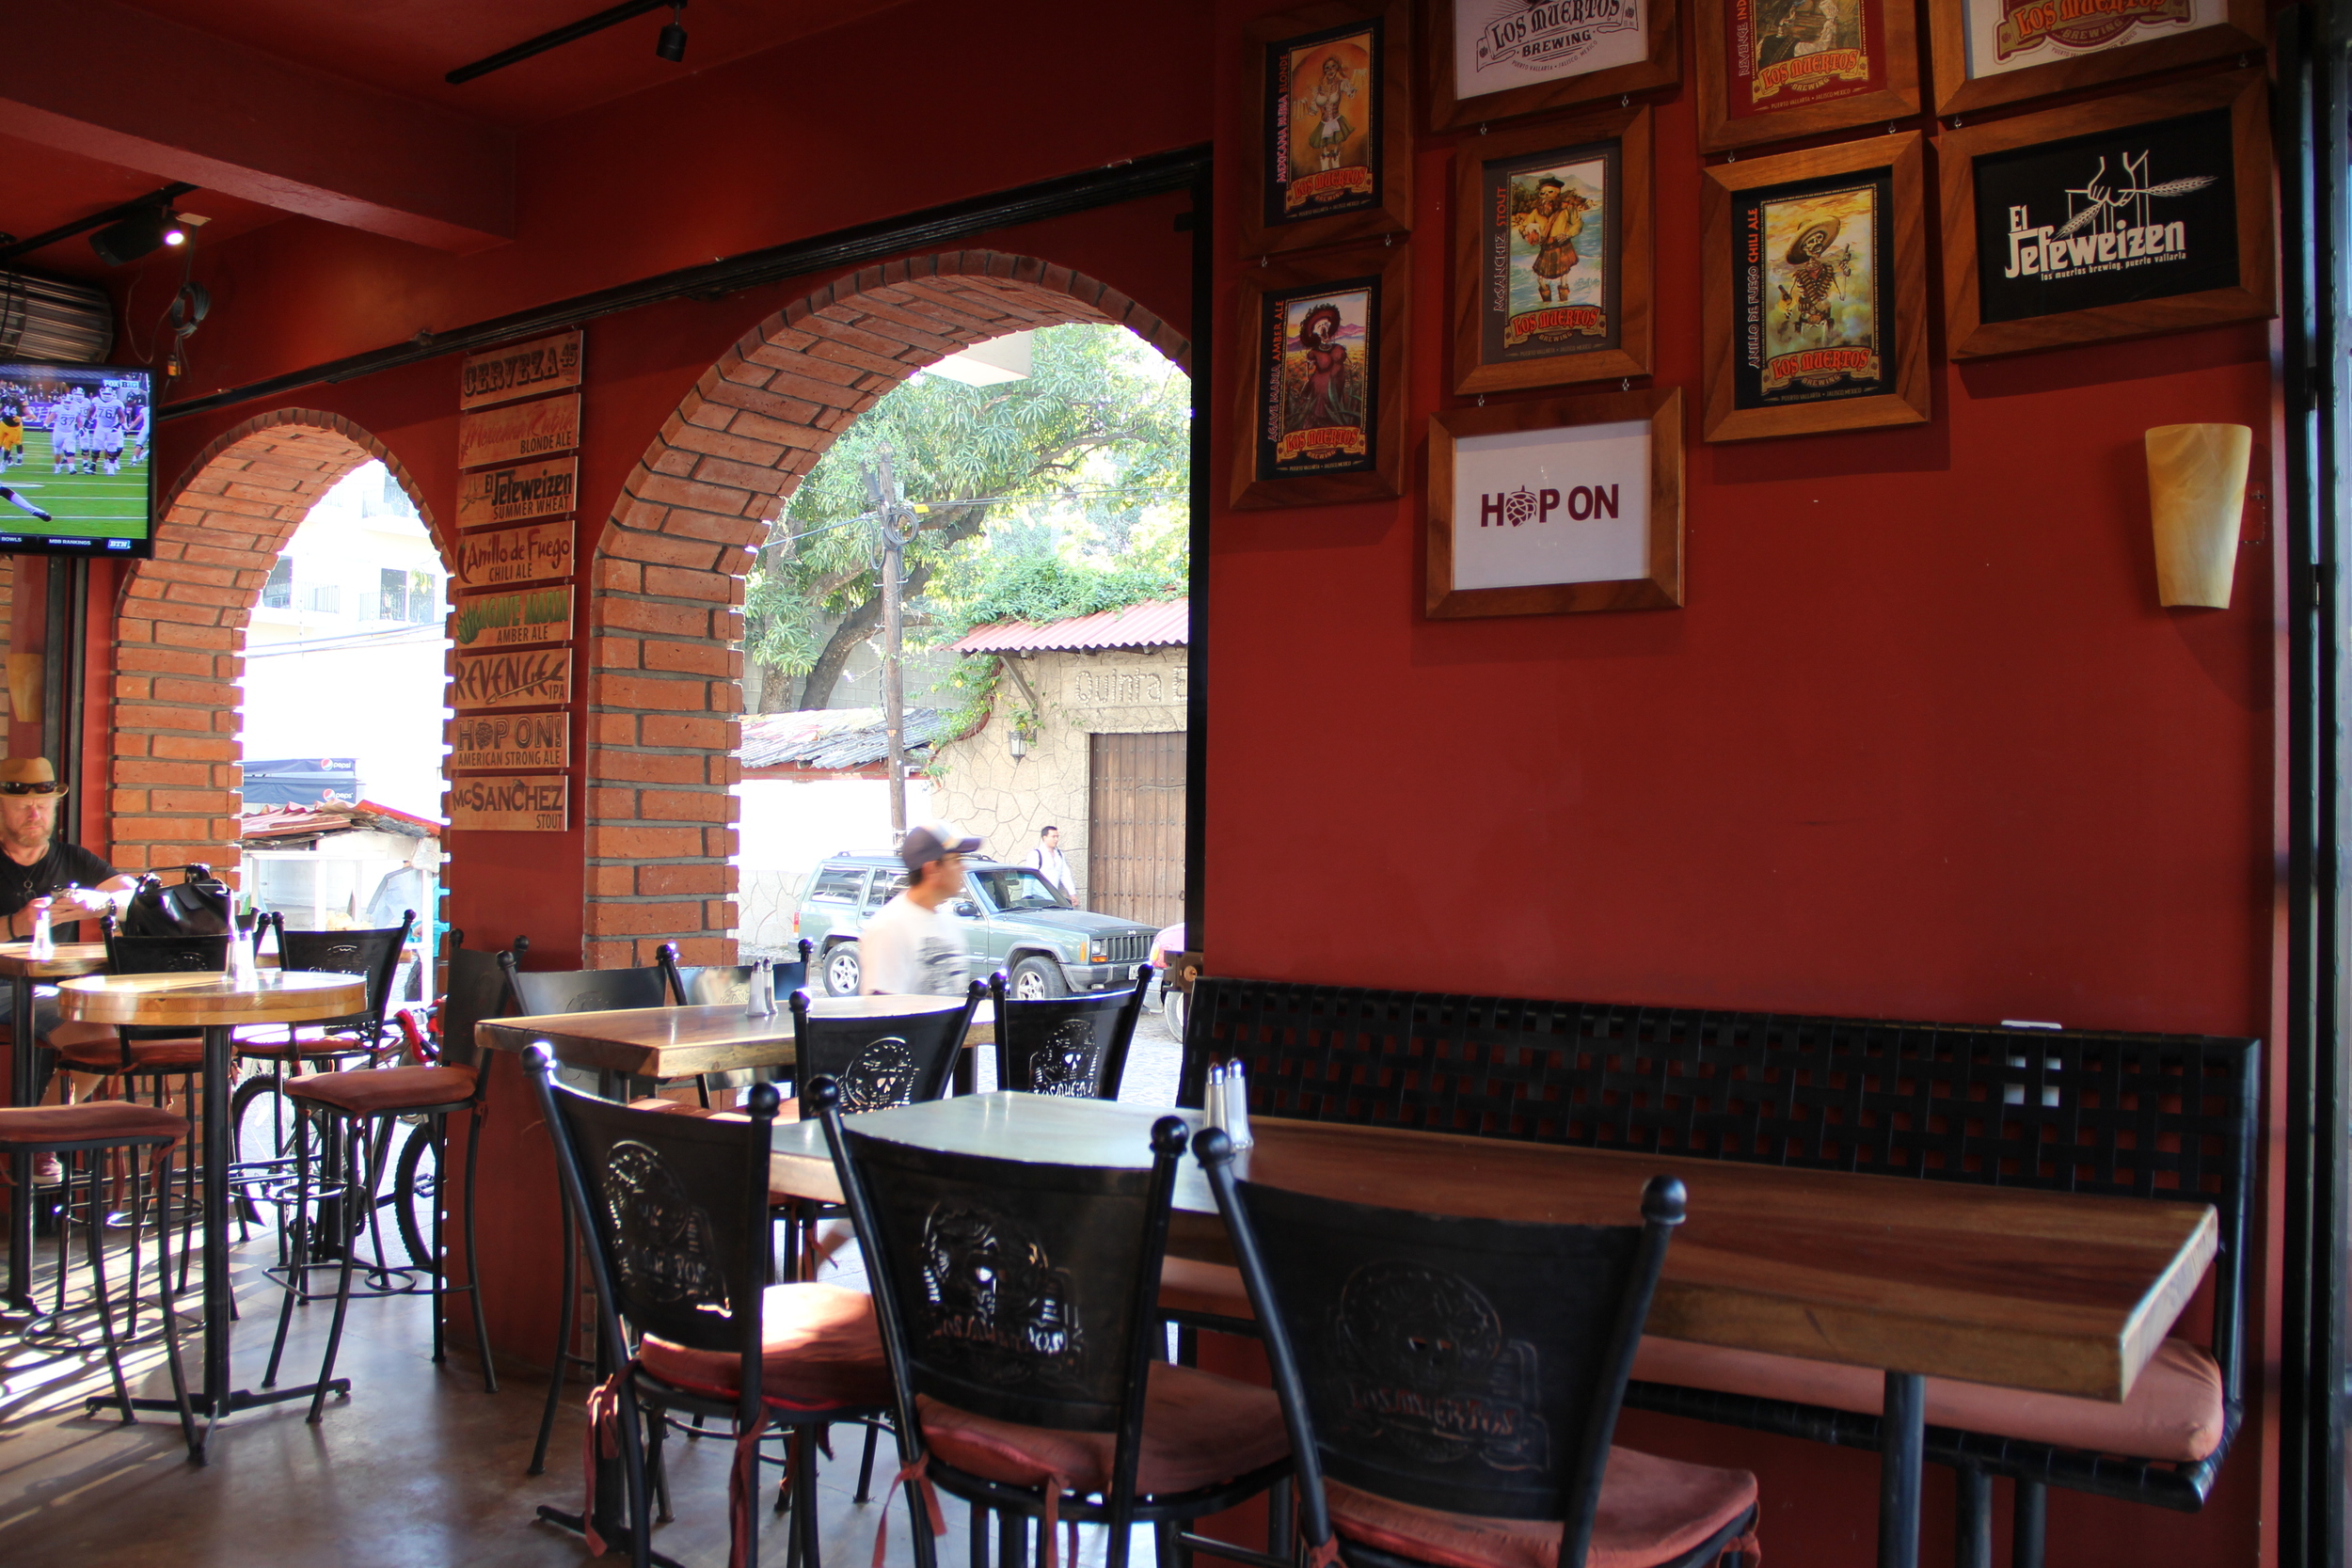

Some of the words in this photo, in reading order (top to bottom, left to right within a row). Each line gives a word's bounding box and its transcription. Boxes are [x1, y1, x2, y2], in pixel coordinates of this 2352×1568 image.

[1492, 15, 1526, 50] LOS
[1531, 0, 1619, 33] MUERTOS
[2015, 1, 2057, 37] LOS
[2062, 18, 2124, 40] BREWING
[1511, 59, 1528, 71] PUERTO
[1580, 40, 1598, 56] MEXICO
[1521, 29, 1592, 57] BREWING
[1736, 22, 1750, 76] REVENGE
[1279, 54, 1289, 93] BLONDE
[1762, 64, 1788, 90] LOS
[1789, 51, 1859, 79] MUERTOS
[1791, 75, 1830, 91] BREWING
[1277, 94, 1289, 127] RUBIA
[1771, 99, 1790, 109] PUERTO
[1277, 126, 1289, 182] MEXICANA
[1293, 178, 1314, 201] LOS
[1313, 167, 1367, 191] MUERTOS
[1496, 186, 1507, 227] STOUT
[1747, 207, 1758, 230] ALE
[2009, 204, 2028, 233] El
[1747, 233, 1759, 263] CHILI
[2005, 220, 2185, 278] Jefeweizen
[1493, 231, 1507, 312] McSANCHEZ
[2041, 273, 2053, 281] los
[2055, 264, 2087, 279] muertos
[2125, 256, 2152, 269] puerto
[2154, 251, 2186, 262] vallarta
[1747, 265, 1759, 304] FUEGO
[1275, 300, 1283, 321] ALE
[1513, 314, 1536, 337] LOS
[1539, 308, 1599, 330] MUERTOS
[1747, 306, 1759, 323] DE
[1272, 322, 1282, 361] AMBER
[1538, 330, 1574, 342] BREWING
[1747, 325, 1759, 369] ANILLO
[463, 347, 560, 397] CERVEZA
[1771, 357, 1800, 382] LOS
[1801, 349, 1871, 372] MUERTOS
[1801, 373, 1841, 387] BREWING
[104, 379, 119, 388] FOX
[1270, 364, 1281, 402] MARIA
[60, 416, 74, 426] 37
[98, 408, 113, 418] 76
[1267, 405, 1279, 442] AGAVE
[520, 435, 553, 454] BLONDE
[555, 431, 572, 449] ALE
[1285, 432, 1306, 452] LOS
[1306, 428, 1360, 447] MUERTOS
[484, 473, 493, 494] El
[491, 469, 572, 506] Jefeweizen
[1567, 483, 1619, 521] ON
[493, 499, 534, 520] SUMMER
[535, 495, 570, 515] WHEAT
[467, 533, 508, 575] Anillo
[510, 531, 525, 562] de
[527, 528, 570, 570] Fuego
[488, 564, 514, 583] CHILI
[515, 562, 532, 579] ALE
[478, 594, 522, 631] AGAVE
[523, 590, 569, 628] MARIA
[496, 626, 530, 645] AMBER
[531, 623, 548, 641] ALE
[454, 653, 552, 702] REVENGE
[548, 684, 564, 701] IPA
[1075, 668, 1162, 707] Quinta
[514, 715, 563, 750] ON!
[457, 751, 502, 767] AMERICAN
[504, 751, 541, 766] STRONG
[542, 751, 561, 766] ALE
[535, 814, 564, 830] STOUT
